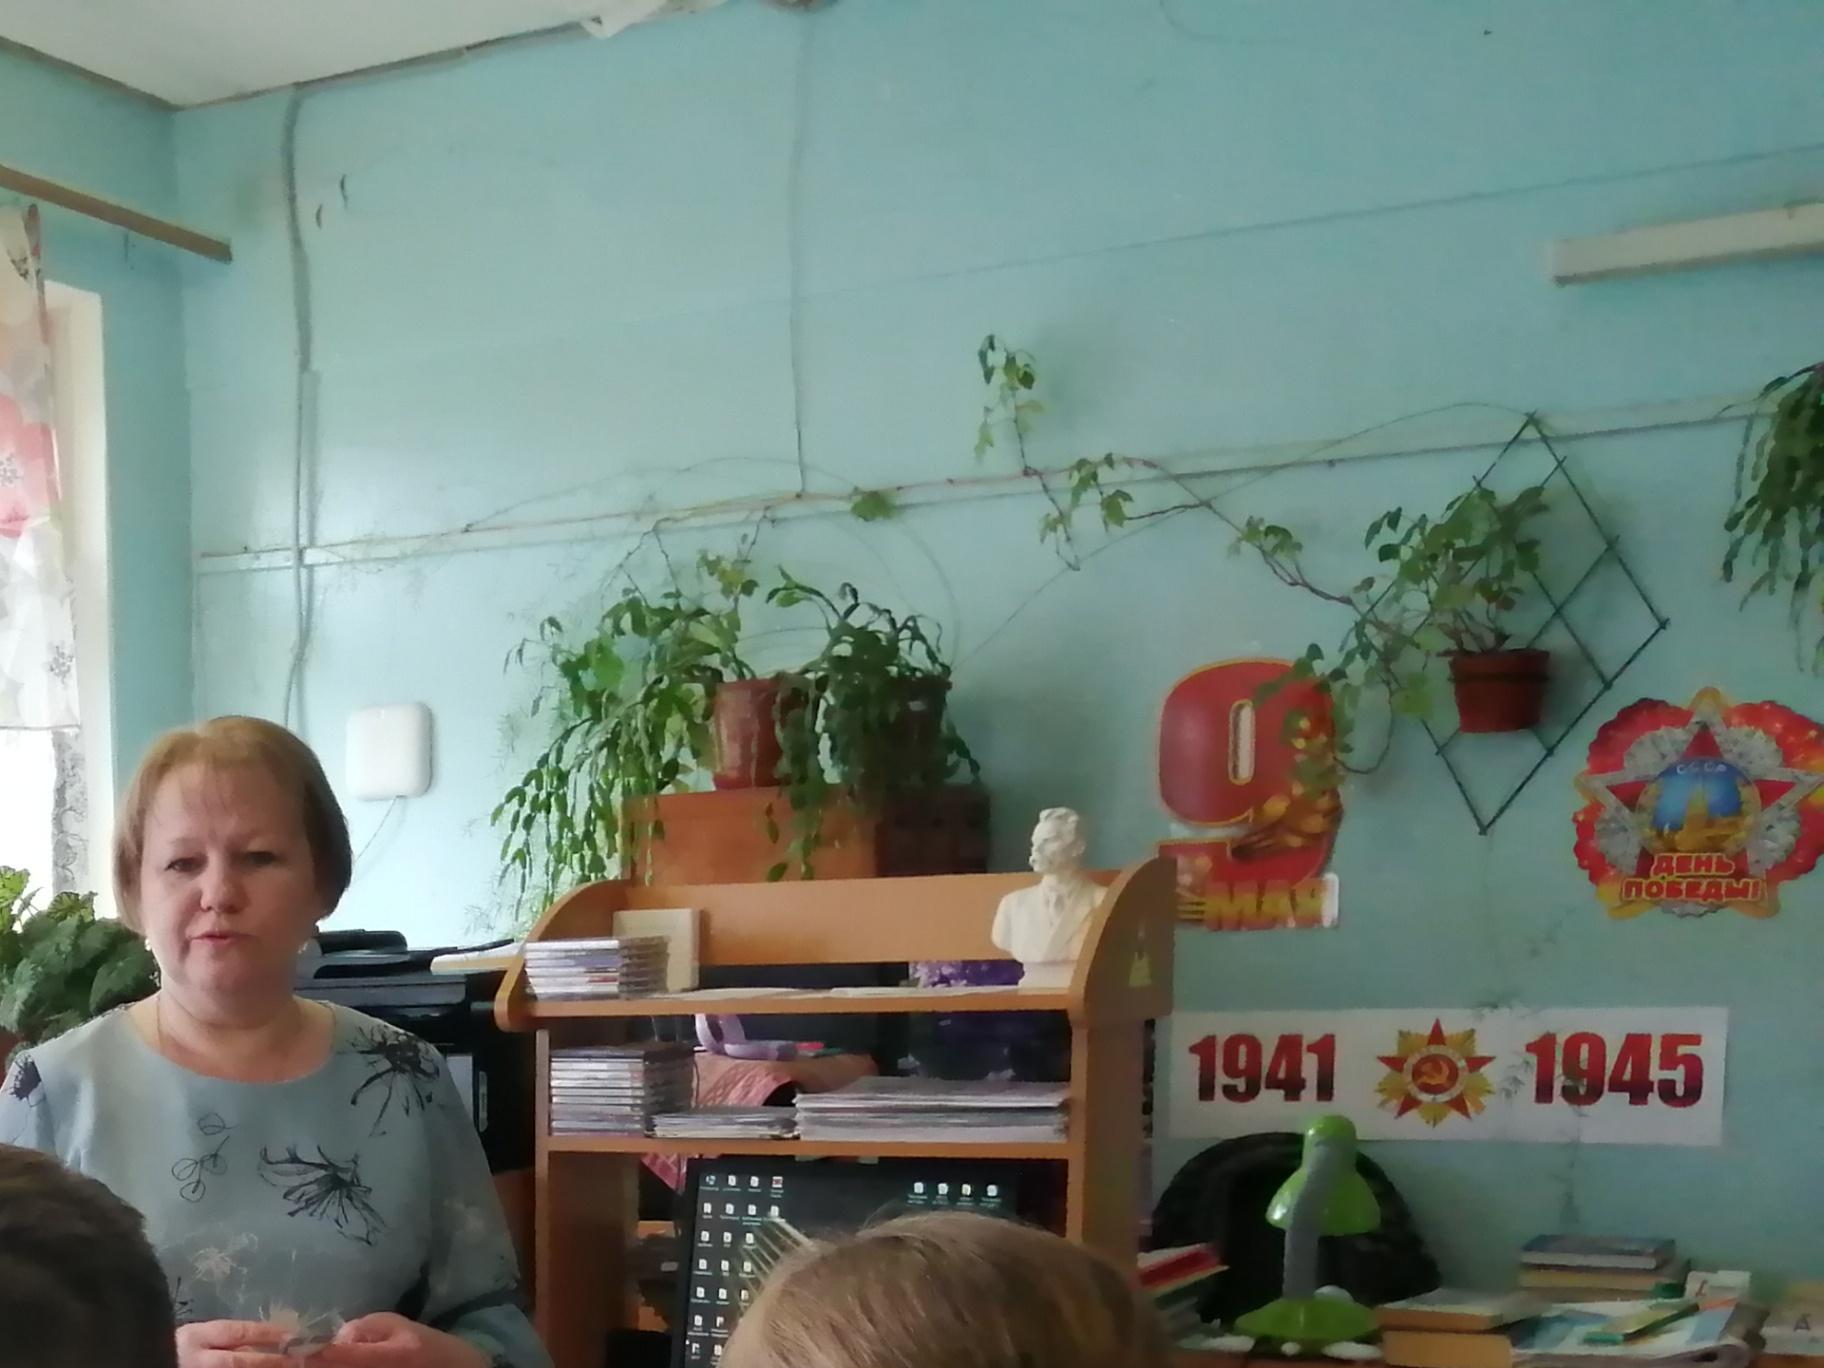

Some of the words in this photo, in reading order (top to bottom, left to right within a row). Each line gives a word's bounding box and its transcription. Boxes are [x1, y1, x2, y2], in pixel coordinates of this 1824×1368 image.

[1158, 658, 1343, 884] 9
[1622, 877, 1763, 903] ПОБЕДЫ!
[1650, 853, 1736, 877] ДЕНЬ
[1205, 877, 1339, 932] МАЯ
[1188, 1032, 1337, 1103] 1941
[1525, 1031, 1706, 1108] 1945
